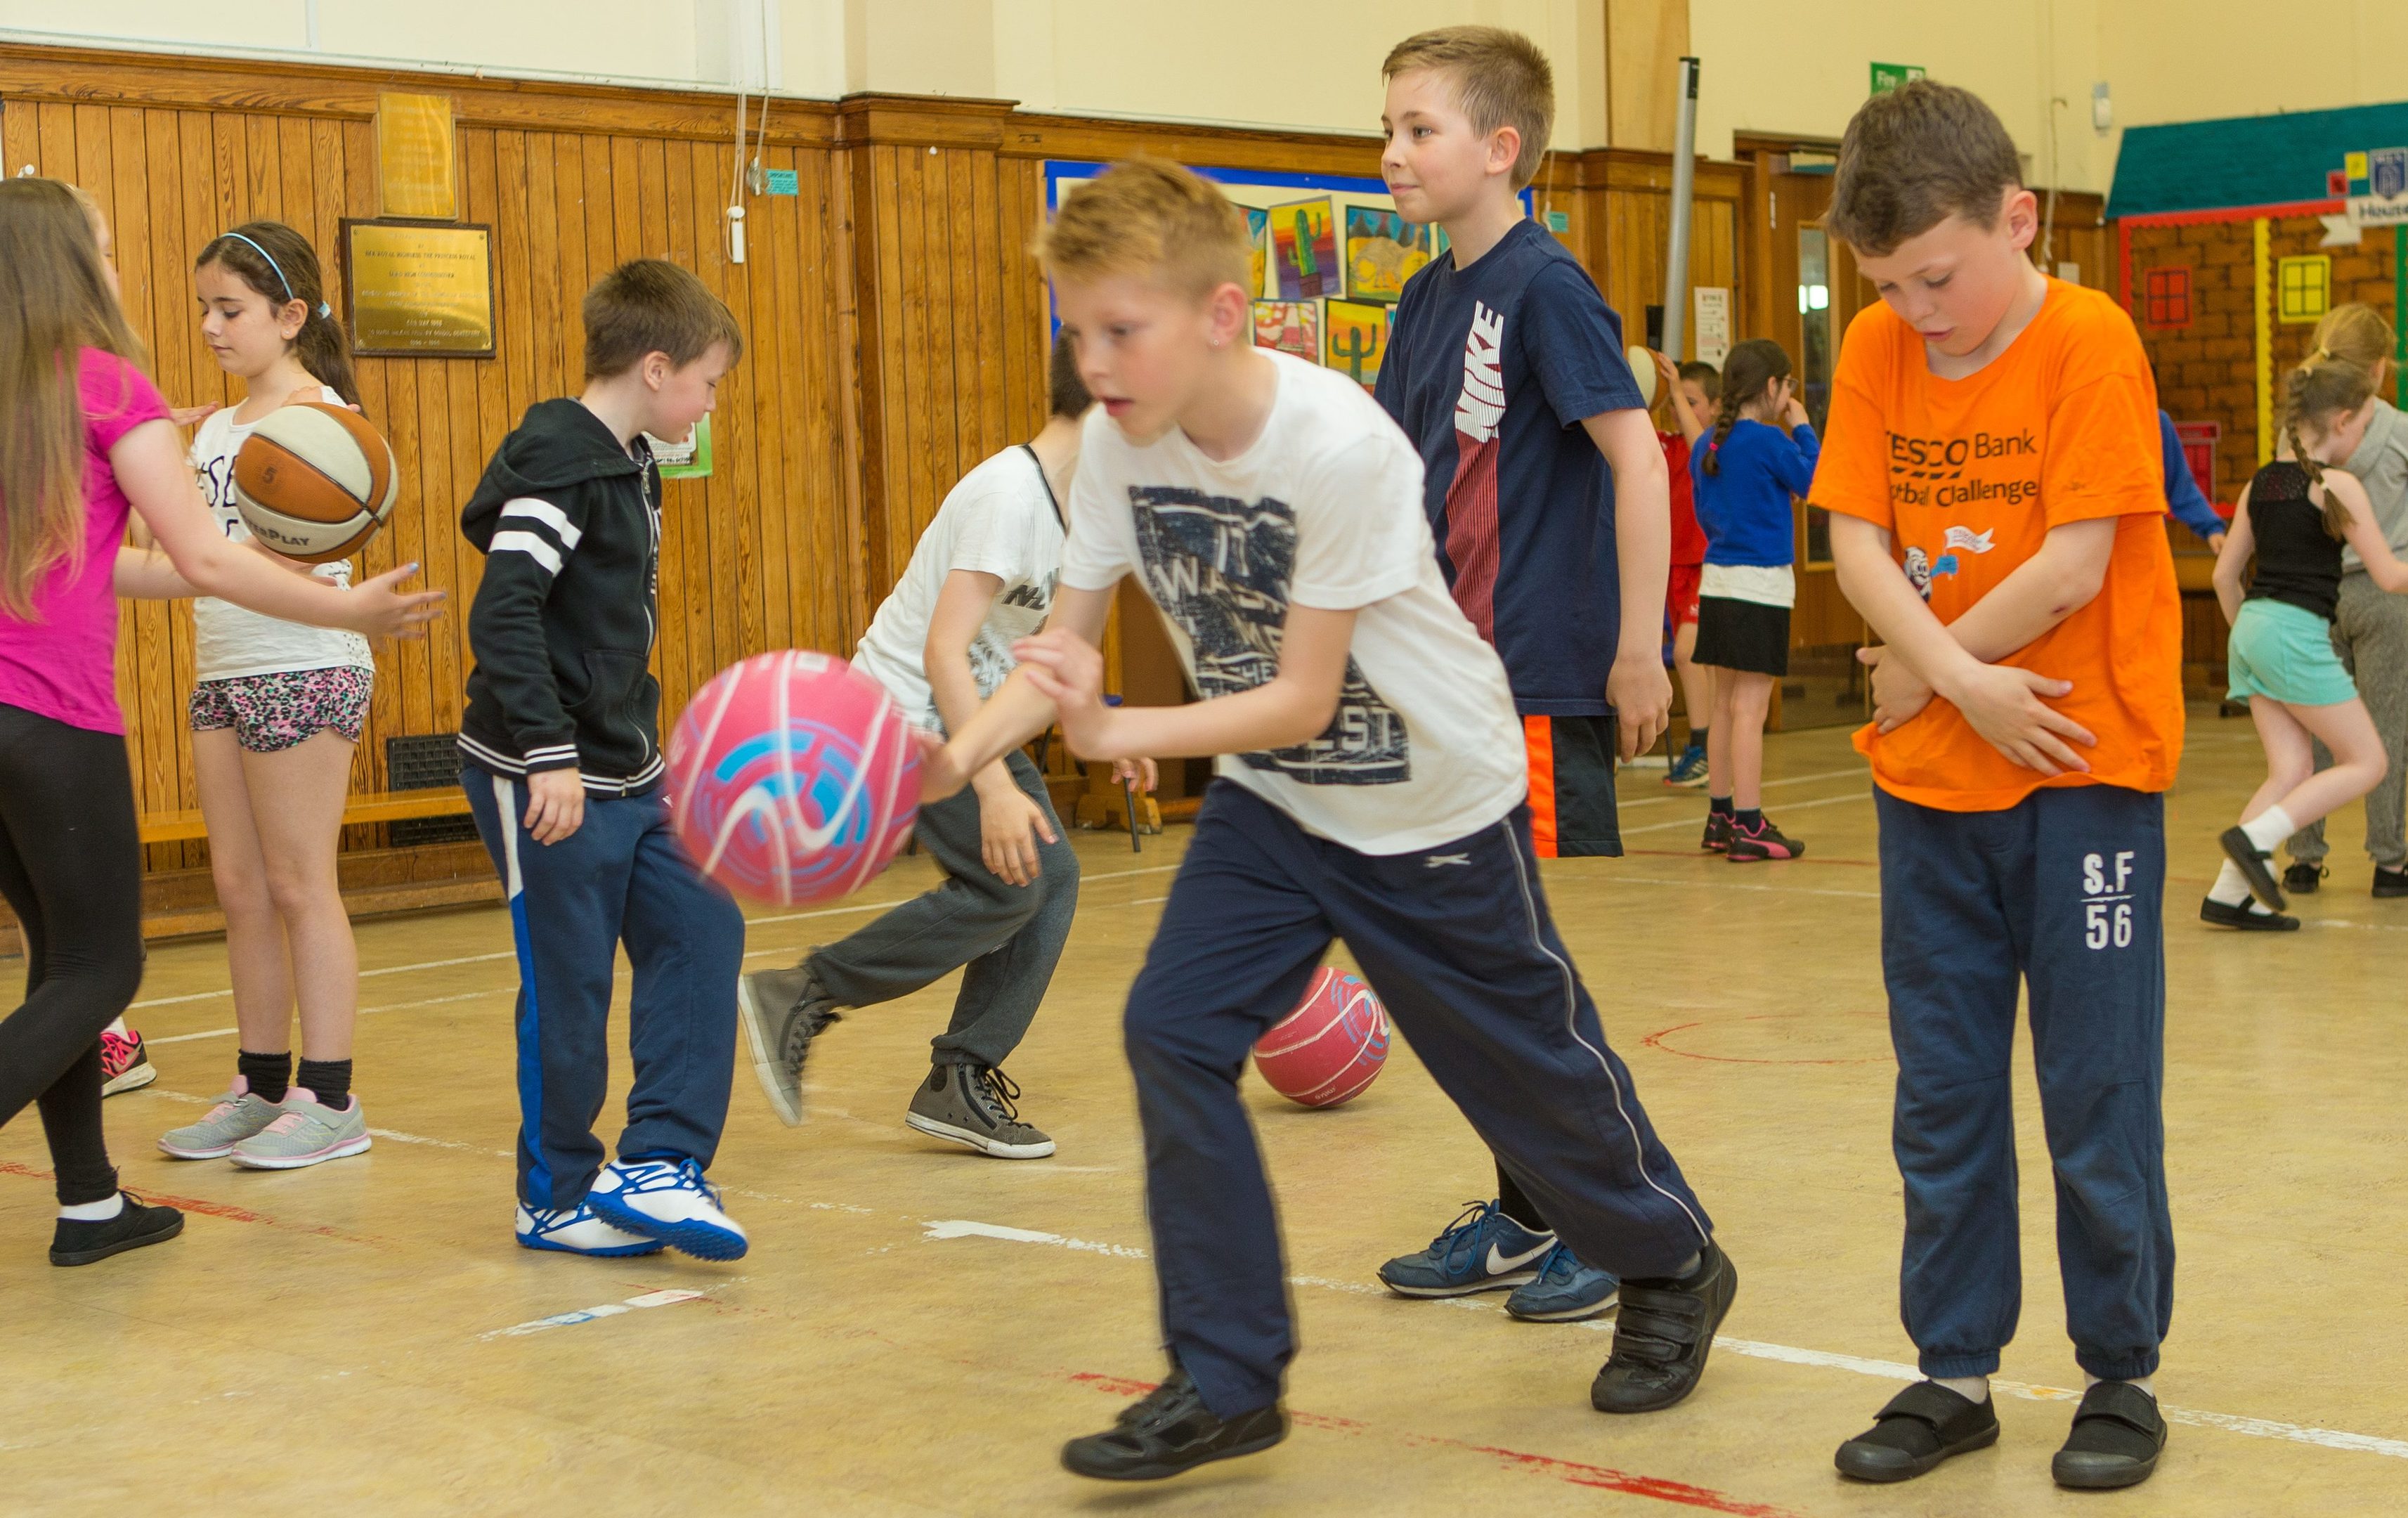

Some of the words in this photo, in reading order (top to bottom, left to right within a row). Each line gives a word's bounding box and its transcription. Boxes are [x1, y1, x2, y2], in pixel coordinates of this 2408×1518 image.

[1454, 299, 1506, 443] NIKE
[1974, 428, 2037, 459] Bank
[2083, 850, 2135, 895] S.F
[2085, 903, 2133, 950] 56
